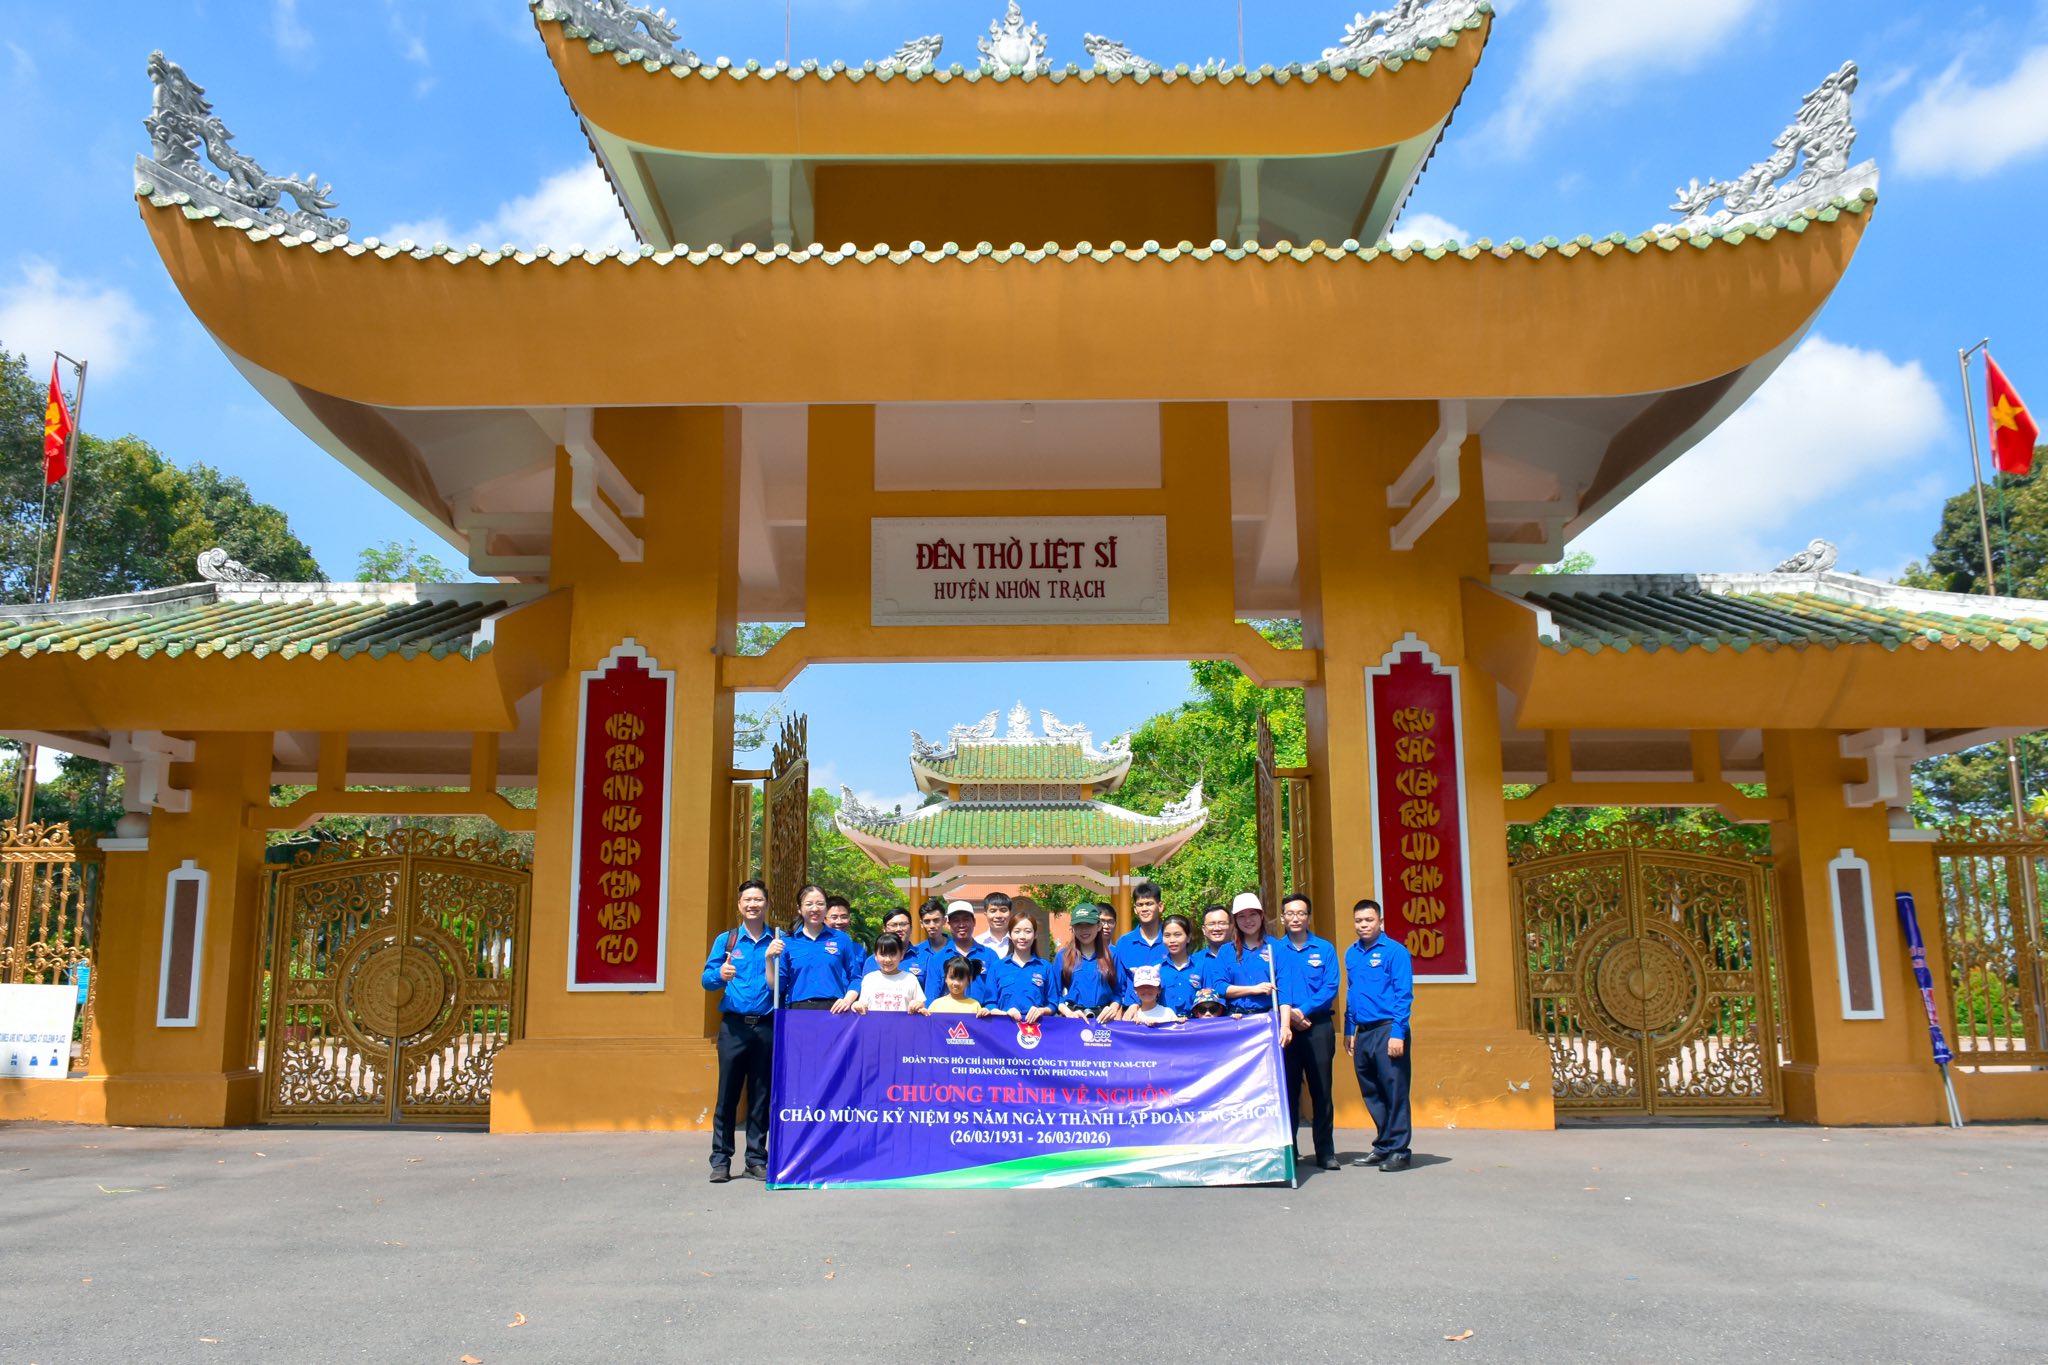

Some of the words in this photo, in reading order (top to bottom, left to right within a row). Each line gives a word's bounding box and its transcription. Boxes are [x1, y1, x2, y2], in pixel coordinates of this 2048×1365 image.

[973, 536, 1023, 570] THỜ
[934, 578, 990, 601] HUYỆN
[995, 578, 1040, 599] NHƠN
[1048, 580, 1106, 601] TRẠCH
[902, 1054, 926, 1064] ĐOÀN
[928, 1056, 949, 1064] TNCS
[965, 1055, 980, 1065] CHÍ
[983, 1058, 1005, 1066] MINH
[1032, 1057, 1056, 1067] CÔNG
[1070, 1058, 1092, 1068] THÉP
[1093, 1060, 1112, 1069] VIỆT
[1113, 1060, 1157, 1068] NAM-CTCP
[969, 1066, 993, 1075] ĐOÀN
[994, 1066, 1018, 1076] CÔNG
[1032, 1067, 1050, 1076] TÔN
[1052, 1068, 1088, 1077] PHƯƠNG
[1088, 1069, 1108, 1077] NAM
[887, 1084, 983, 1103] CHƯƠNG
[988, 1082, 1056, 1104] TRÌNH
[1062, 1083, 1091, 1105] VỀ
[779, 1106, 826, 1123] CHÀO
[829, 1107, 878, 1123] MỪNG
[882, 1107, 905, 1123] KỶ
[909, 1109, 950, 1127] NIỆM
[953, 1111, 969, 1124] 95
[973, 1108, 1008, 1125] NĂM
[1012, 1108, 1055, 1125] NGÀY
[1059, 1109, 1114, 1125] THÀNH
[1118, 1109, 1148, 1128] LẬP
[1151, 1107, 1195, 1125] ĐOÀN
[950, 1130, 1023, 1145] (26/03/1931
[1037, 1131, 1111, 1144] 26/03/2026)
